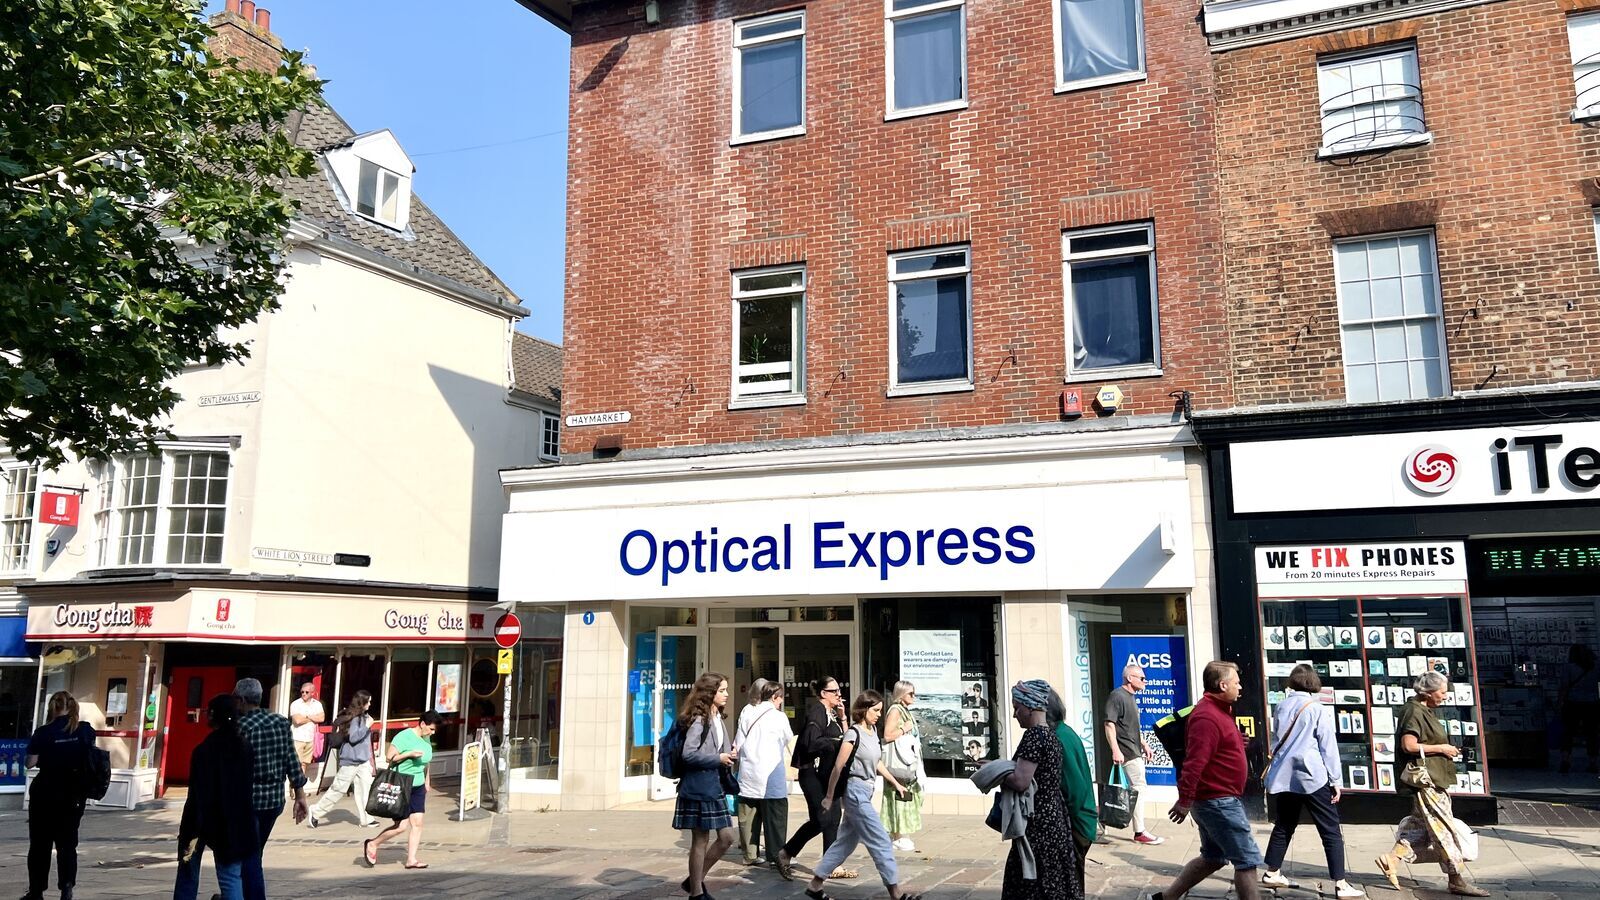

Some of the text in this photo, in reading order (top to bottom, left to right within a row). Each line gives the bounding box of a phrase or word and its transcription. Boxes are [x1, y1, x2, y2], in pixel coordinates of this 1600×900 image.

[200, 392, 259, 405] GENTLEMANS WALK
[571, 412, 625, 425] HAYMARKET
[257, 549, 330, 563] WHITE LION STREET
[619, 521, 1036, 587] Optical Express
[1265, 546, 1455, 569] WE FIX PHONES
[1285, 568, 1436, 579] From 20 minutes Express Repairs
[102, 601, 134, 627] cha
[384, 607, 429, 635] Gong
[437, 608, 464, 631] cha
[1127, 654, 1172, 669] ACES
[640, 669, 671, 685] £55
[1142, 697, 1160, 705] little
